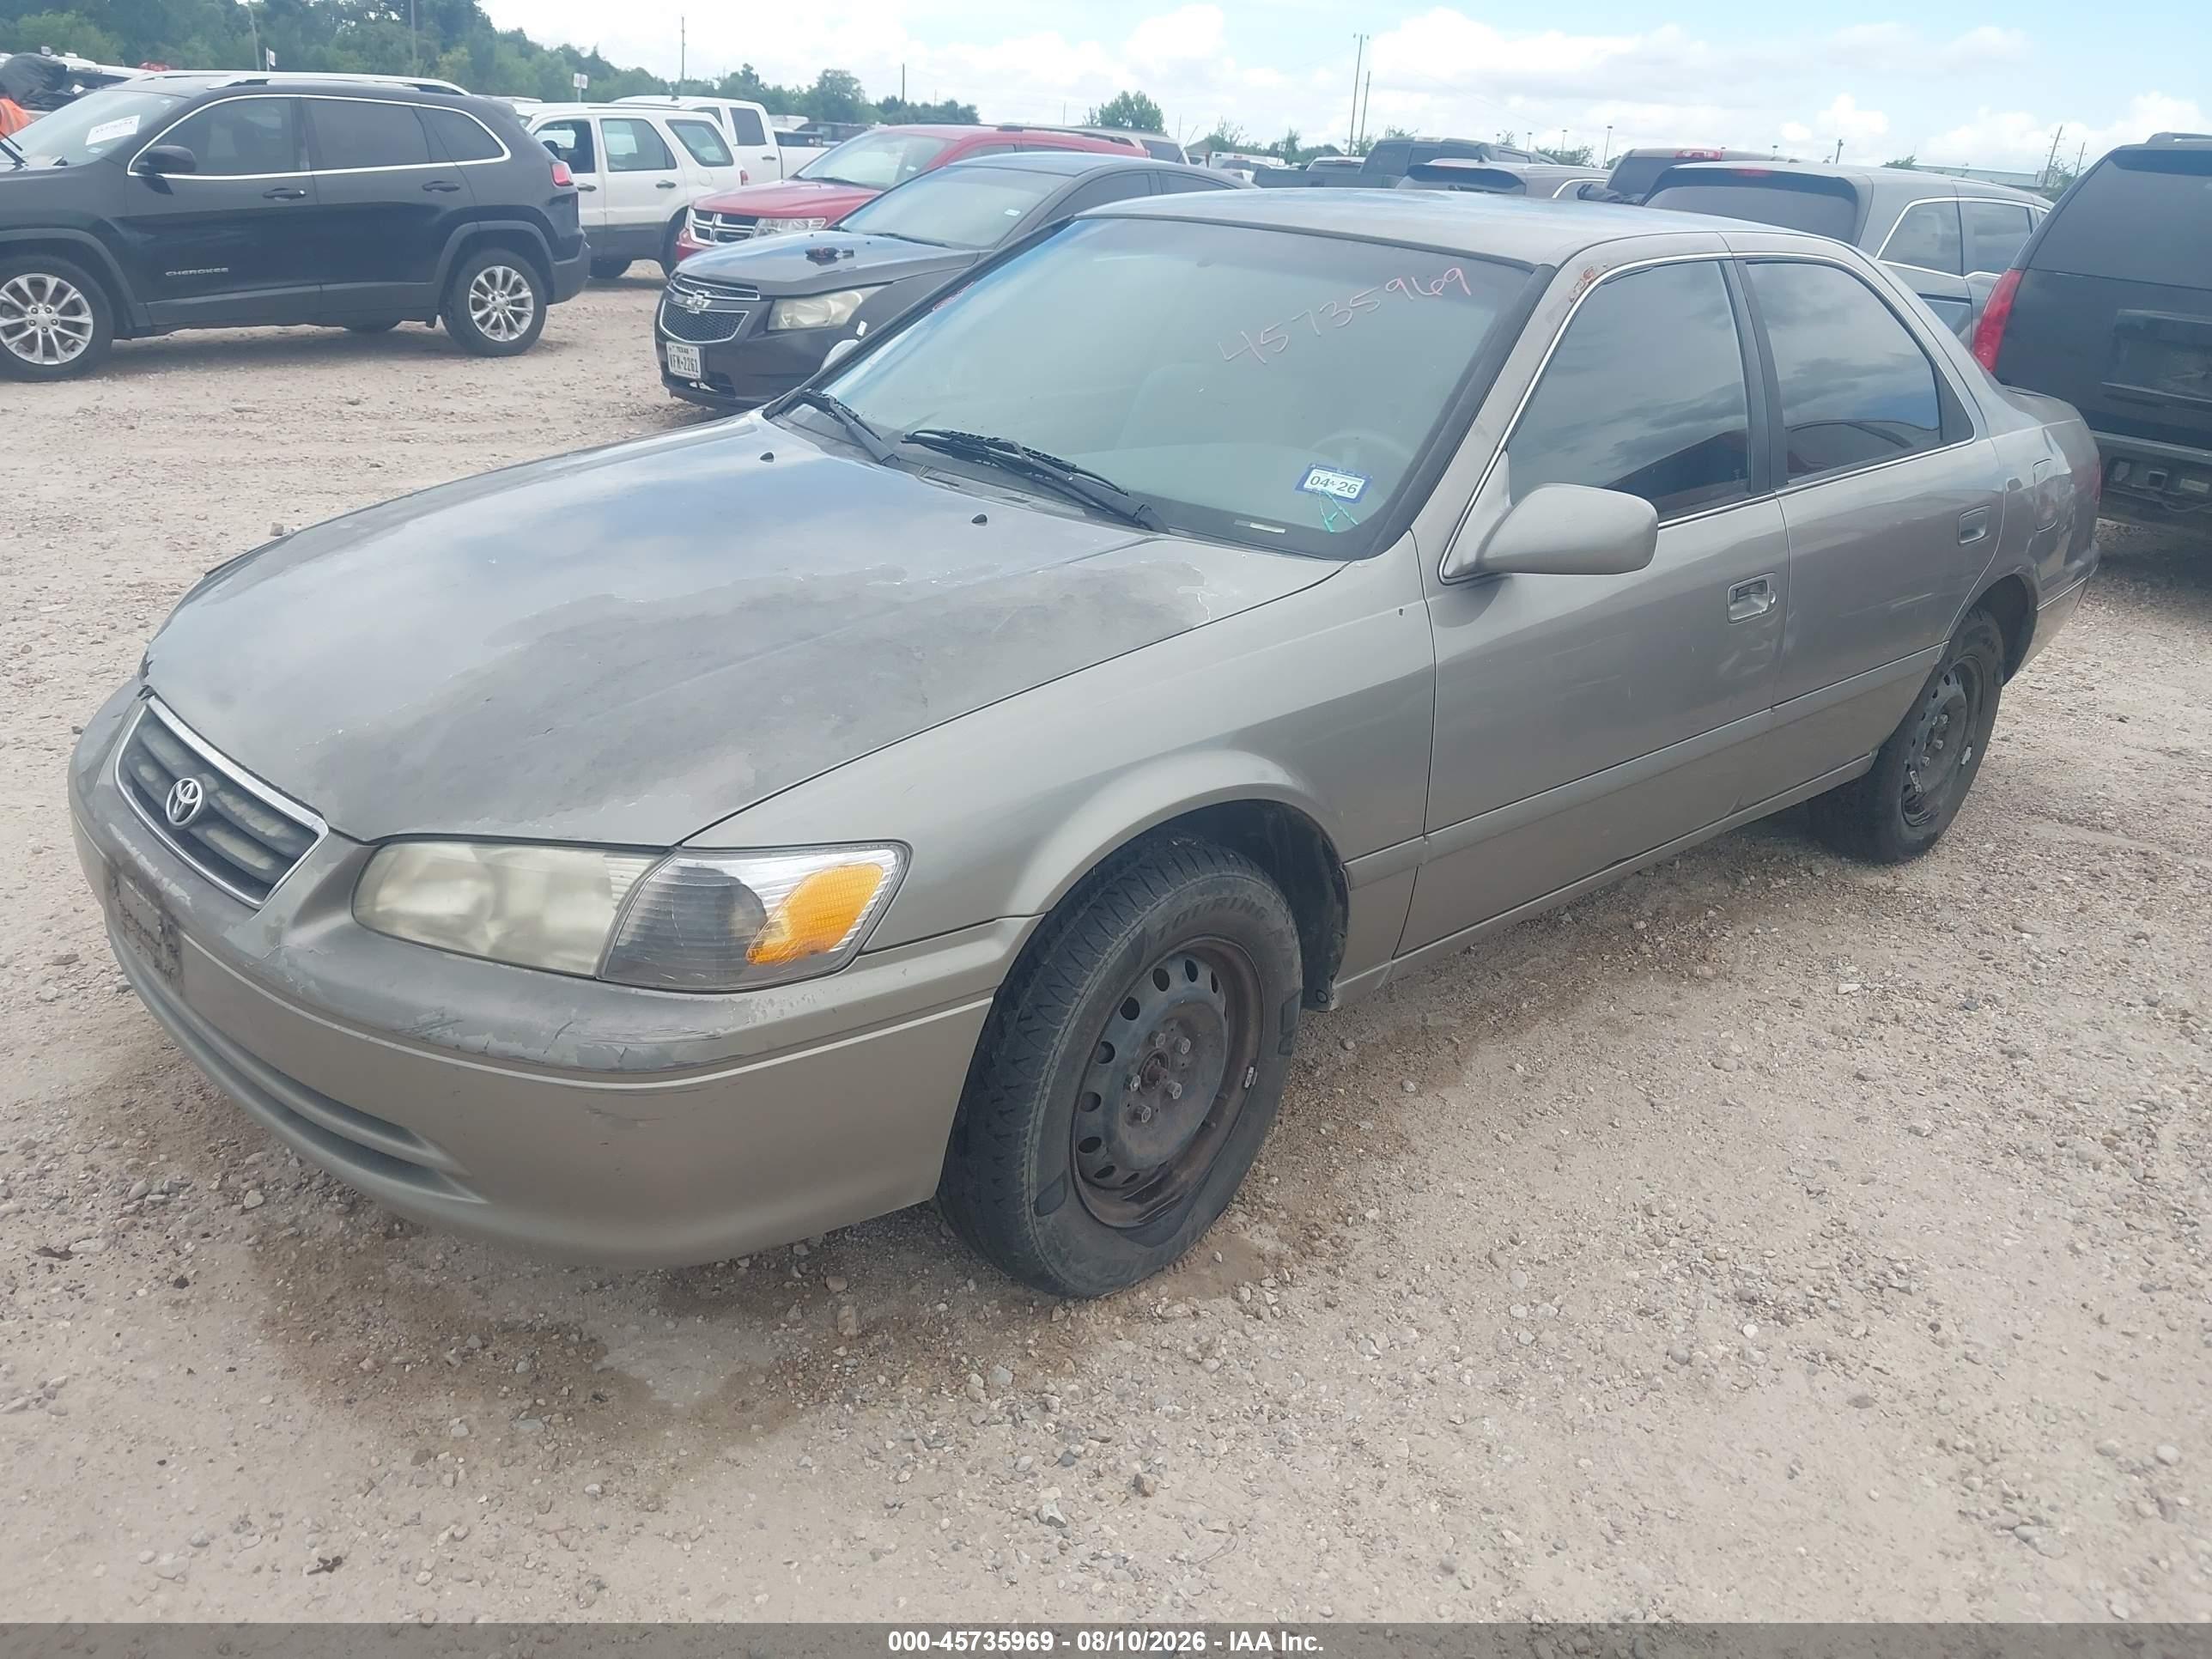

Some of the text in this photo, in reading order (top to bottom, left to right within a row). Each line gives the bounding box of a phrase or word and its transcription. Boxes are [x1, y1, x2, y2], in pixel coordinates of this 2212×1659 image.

[165, 267, 228, 276] CHEROKEE
[1218, 267, 1472, 364] 45735969
[1310, 476, 1358, 494] 04 26
